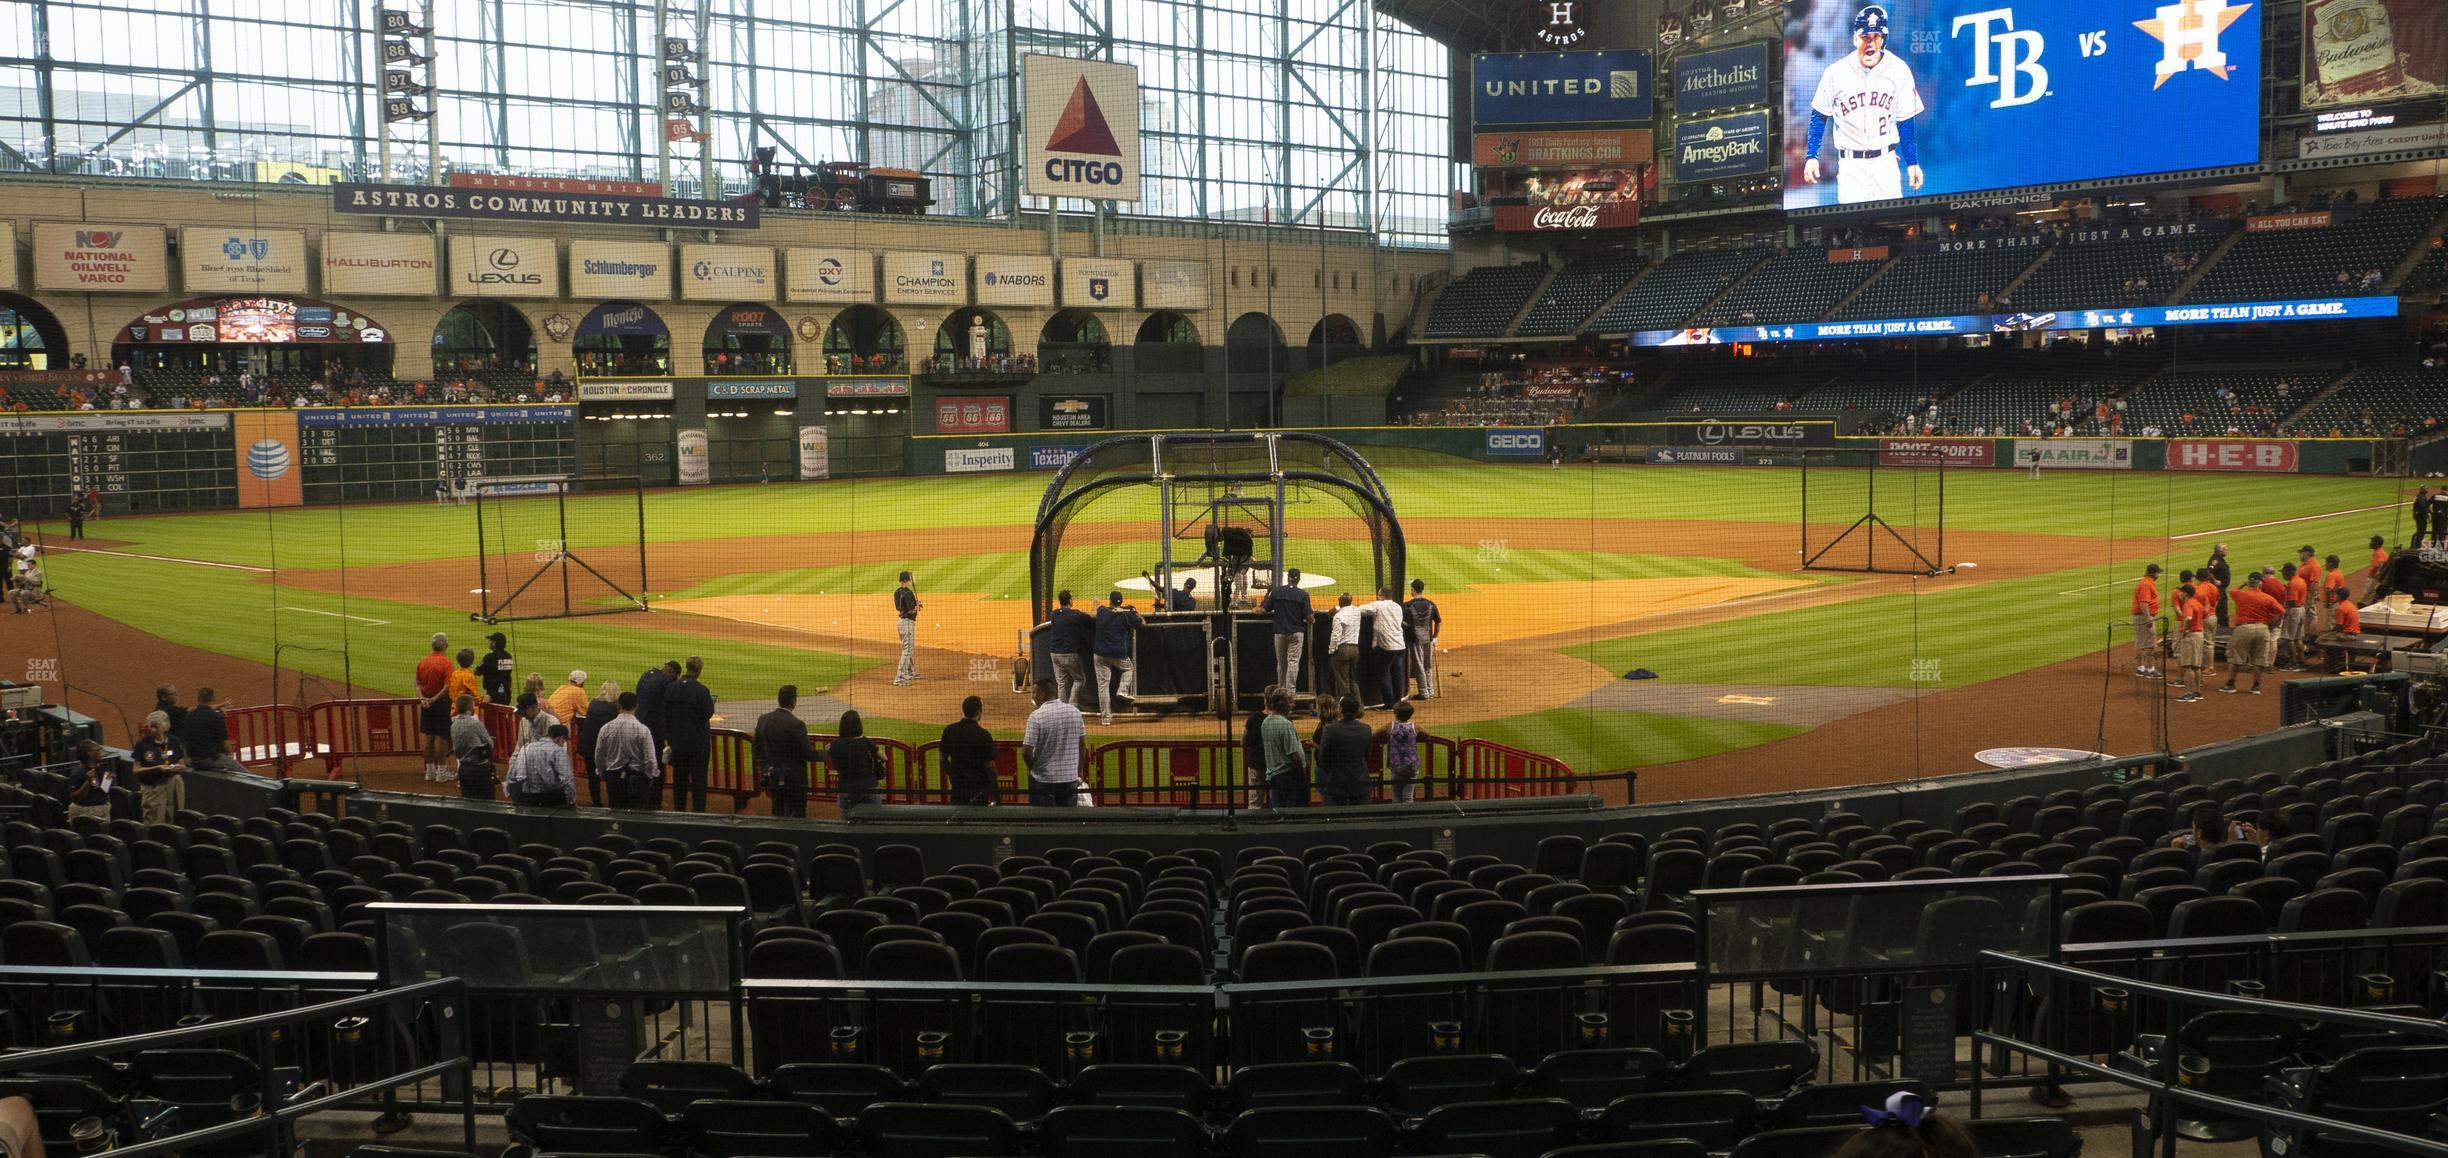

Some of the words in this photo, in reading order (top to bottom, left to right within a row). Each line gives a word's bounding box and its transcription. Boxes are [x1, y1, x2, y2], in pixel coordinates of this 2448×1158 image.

[388, 16, 405, 28] 80
[1538, 28, 1586, 45] ASTROS
[669, 43, 684, 54] 99
[2078, 30, 2108, 58] VS
[389, 45, 406, 57] 86
[390, 74, 406, 86] 97
[671, 70, 686, 80] 01
[1681, 64, 1759, 92] Methodist
[1486, 78, 1602, 97] UNITED
[391, 102, 408, 115] 98
[672, 97, 687, 107] 04
[1839, 91, 1894, 117] ASTROS
[673, 124, 688, 134] 05
[1528, 147, 1621, 161] DRAFTKINGS.COM
[1045, 158, 1123, 185] CITGO
[474, 177, 565, 190] MINUTE
[588, 183, 645, 194] MAID
[353, 190, 456, 209] ASTROS
[470, 195, 631, 218] COMMUNITY
[642, 203, 746, 222] LEADERS
[1950, 193, 2052, 210] DAKTRONICS
[2257, 220, 2273, 228] ALL
[2292, 217, 2310, 226] CAN
[1940, 240, 1986, 253] MORE
[1996, 235, 2041, 248] THAN
[2069, 230, 2109, 244] JUST
[2121, 229, 2130, 238] A
[64, 251, 136, 262] NATIONAL
[327, 257, 432, 269] HALLIBURTON
[71, 262, 131, 273] OILWELL
[584, 259, 657, 279] Schlumberger
[713, 265, 765, 279] CALPINE
[819, 267, 843, 276] OXY
[78, 273, 125, 283] VARCO
[468, 272, 542, 285] LEXUS
[896, 275, 955, 288] CHAMPION
[1000, 274, 1046, 286] NABORS
[2165, 307, 2209, 321] MORE
[2211, 306, 2251, 319] THAN
[2252, 305, 2283, 320] JUST
[2284, 304, 2295, 316] A
[2297, 302, 2348, 315] GAME.
[1817, 325, 1851, 336] MORE
[1852, 323, 1882, 335] THAN
[1882, 321, 1906, 335] JUST
[1907, 321, 1916, 332] A
[1917, 320, 1955, 332] GAME.
[583, 385, 620, 395] HOUSTON
[627, 385, 668, 394] CHRONICLE
[714, 385, 721, 394] C
[730, 385, 738, 394] D
[741, 386, 765, 394] SCRAP
[767, 385, 790, 394] METAL
[942, 412, 954, 423] 66
[966, 412, 978, 423] 66
[989, 411, 1001, 422] 66
[1728, 425, 1805, 439] LEXUS
[1489, 434, 1541, 449] GEICO
[962, 452, 1013, 468] Insperity
[2057, 450, 2091, 460] AIR
